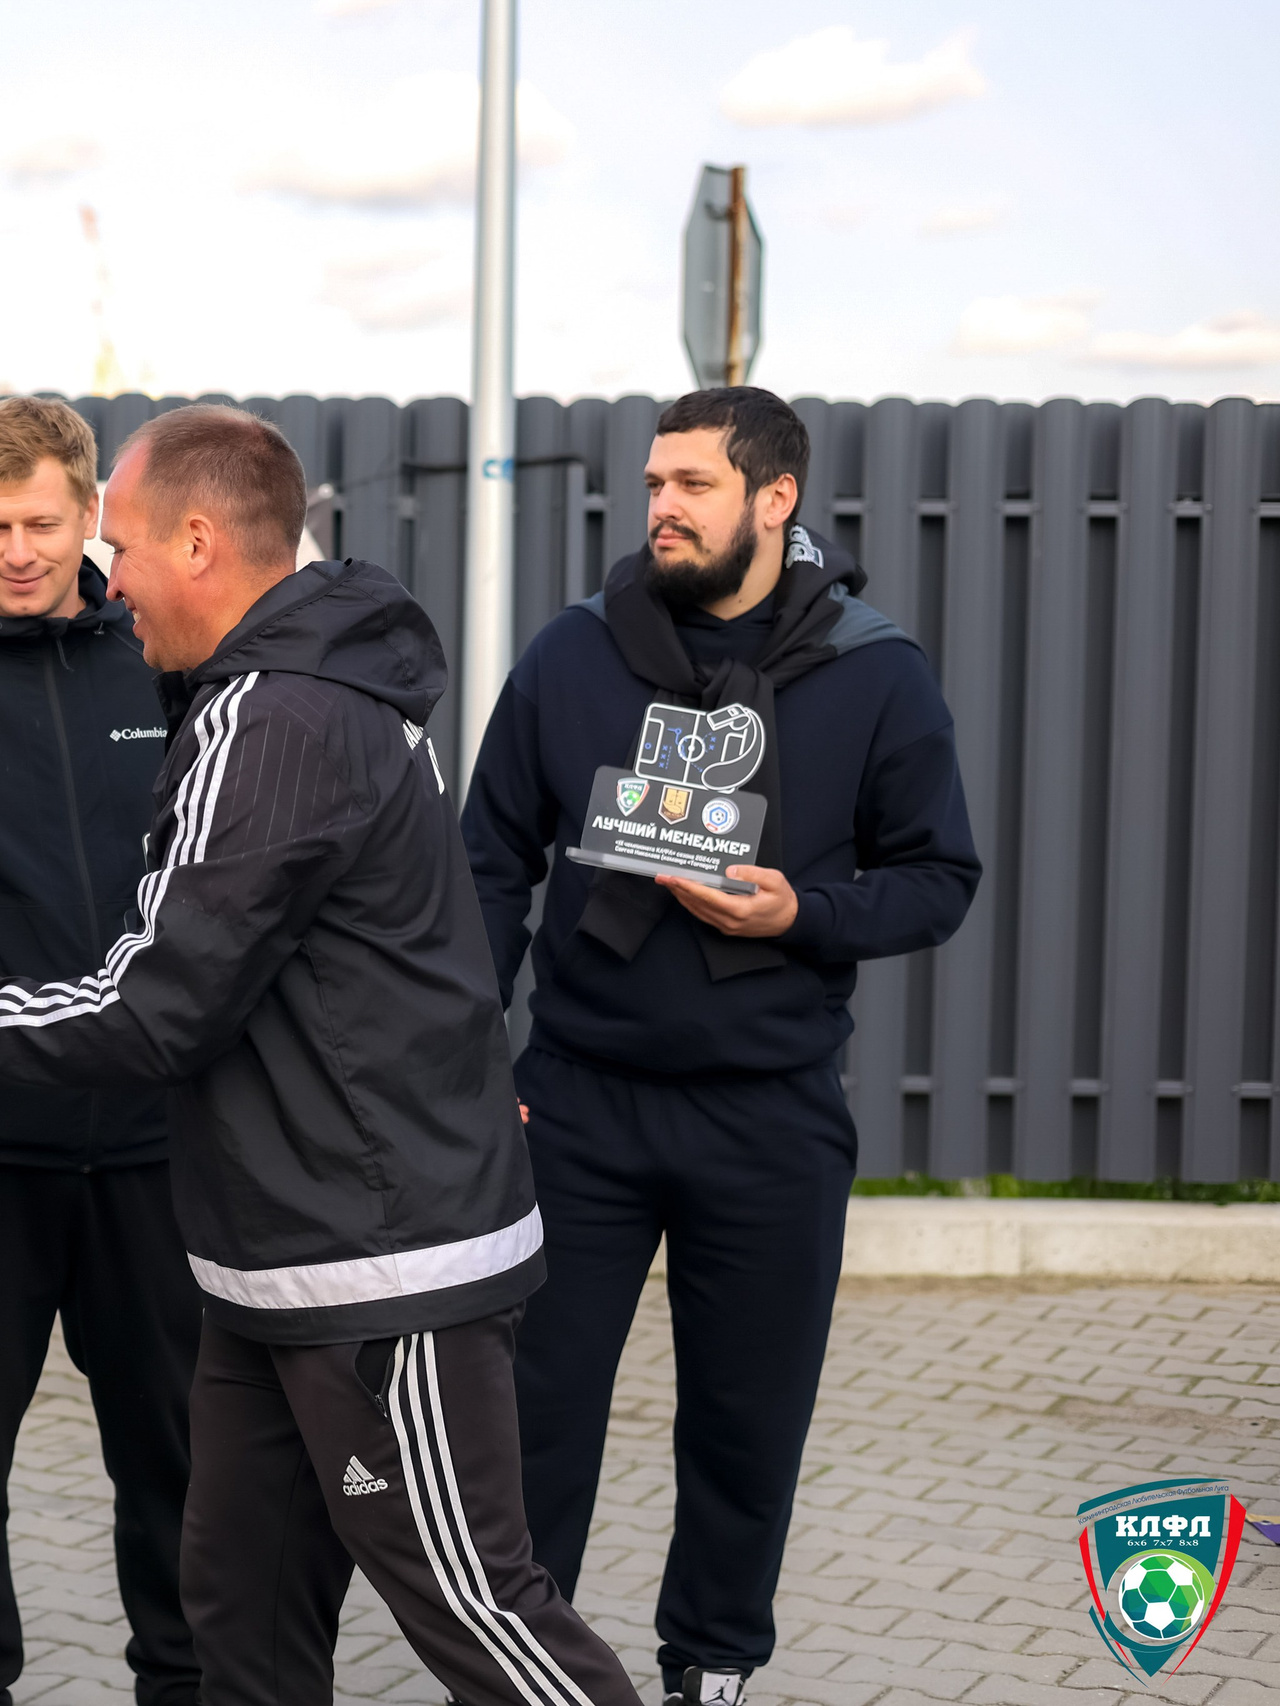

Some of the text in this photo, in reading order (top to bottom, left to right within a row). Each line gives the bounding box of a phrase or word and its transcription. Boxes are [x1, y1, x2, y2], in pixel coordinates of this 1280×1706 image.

[121, 727, 168, 740] Columbia
[592, 815, 751, 856] ЛУЧШИЙ МЕНЕДЖЕР
[343, 1479, 388, 1496] adidas
